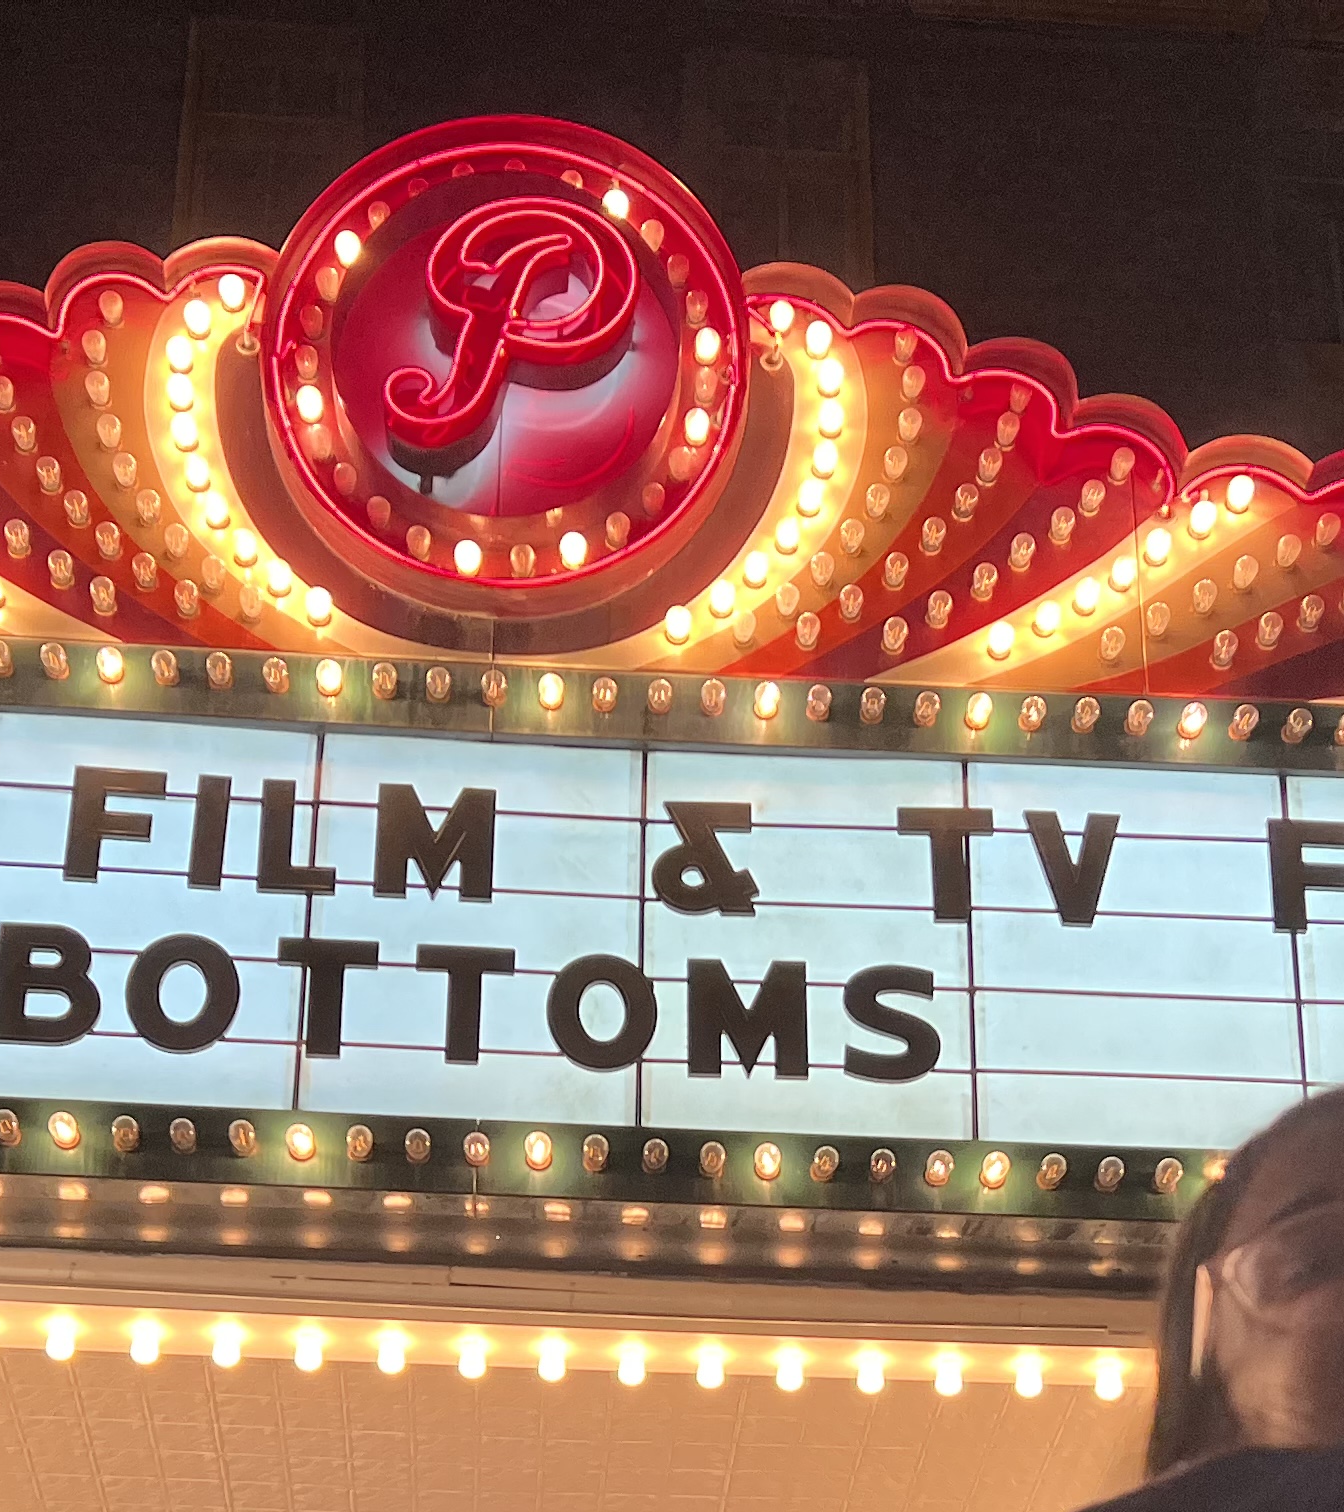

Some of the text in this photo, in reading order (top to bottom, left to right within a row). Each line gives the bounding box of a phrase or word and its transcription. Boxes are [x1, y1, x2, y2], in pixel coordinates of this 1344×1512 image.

[62, 765, 498, 902] FILM
[651, 800, 760, 917] &
[897, 806, 1120, 927] TV
